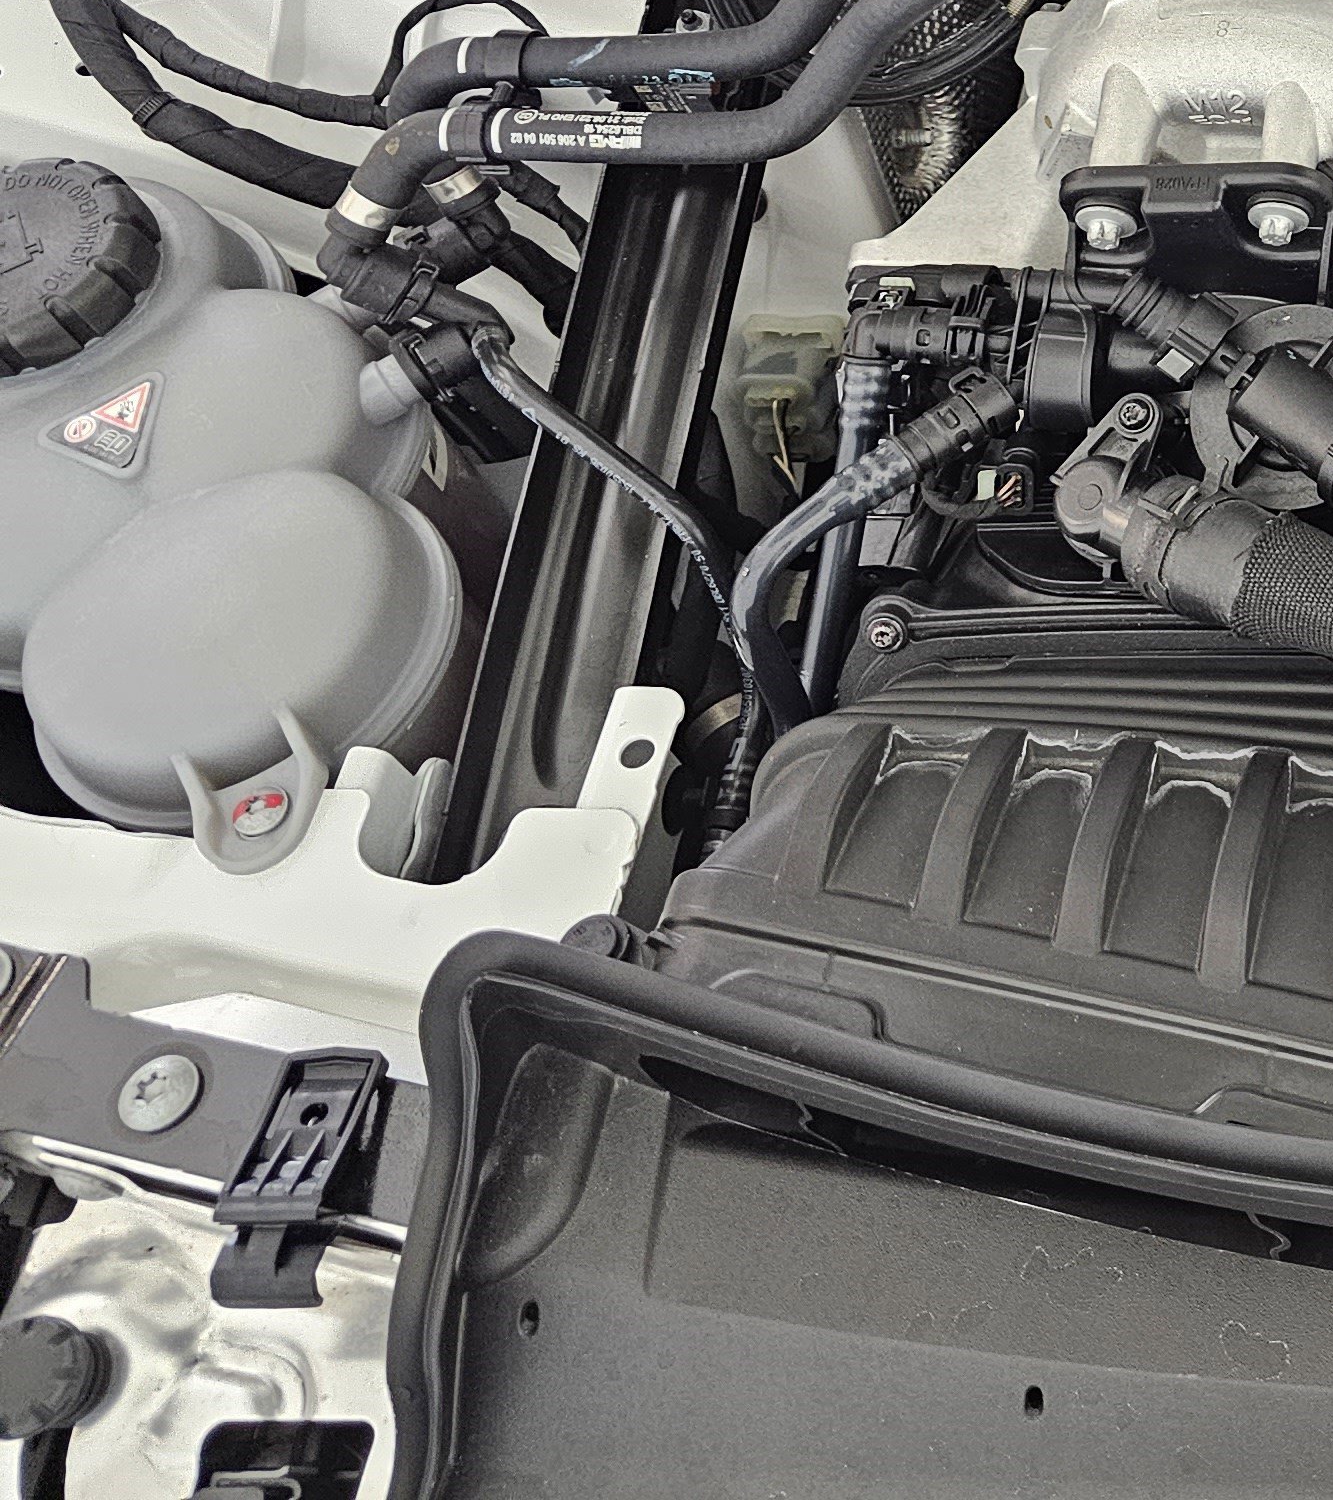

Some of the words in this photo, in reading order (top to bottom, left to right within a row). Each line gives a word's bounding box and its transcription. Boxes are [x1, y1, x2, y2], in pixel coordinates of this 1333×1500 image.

[4, 173, 31, 191] DO
[35, 172, 73, 191] NOT
[67, 184, 100, 220] OPEN
[65, 219, 101, 266] WHEN
